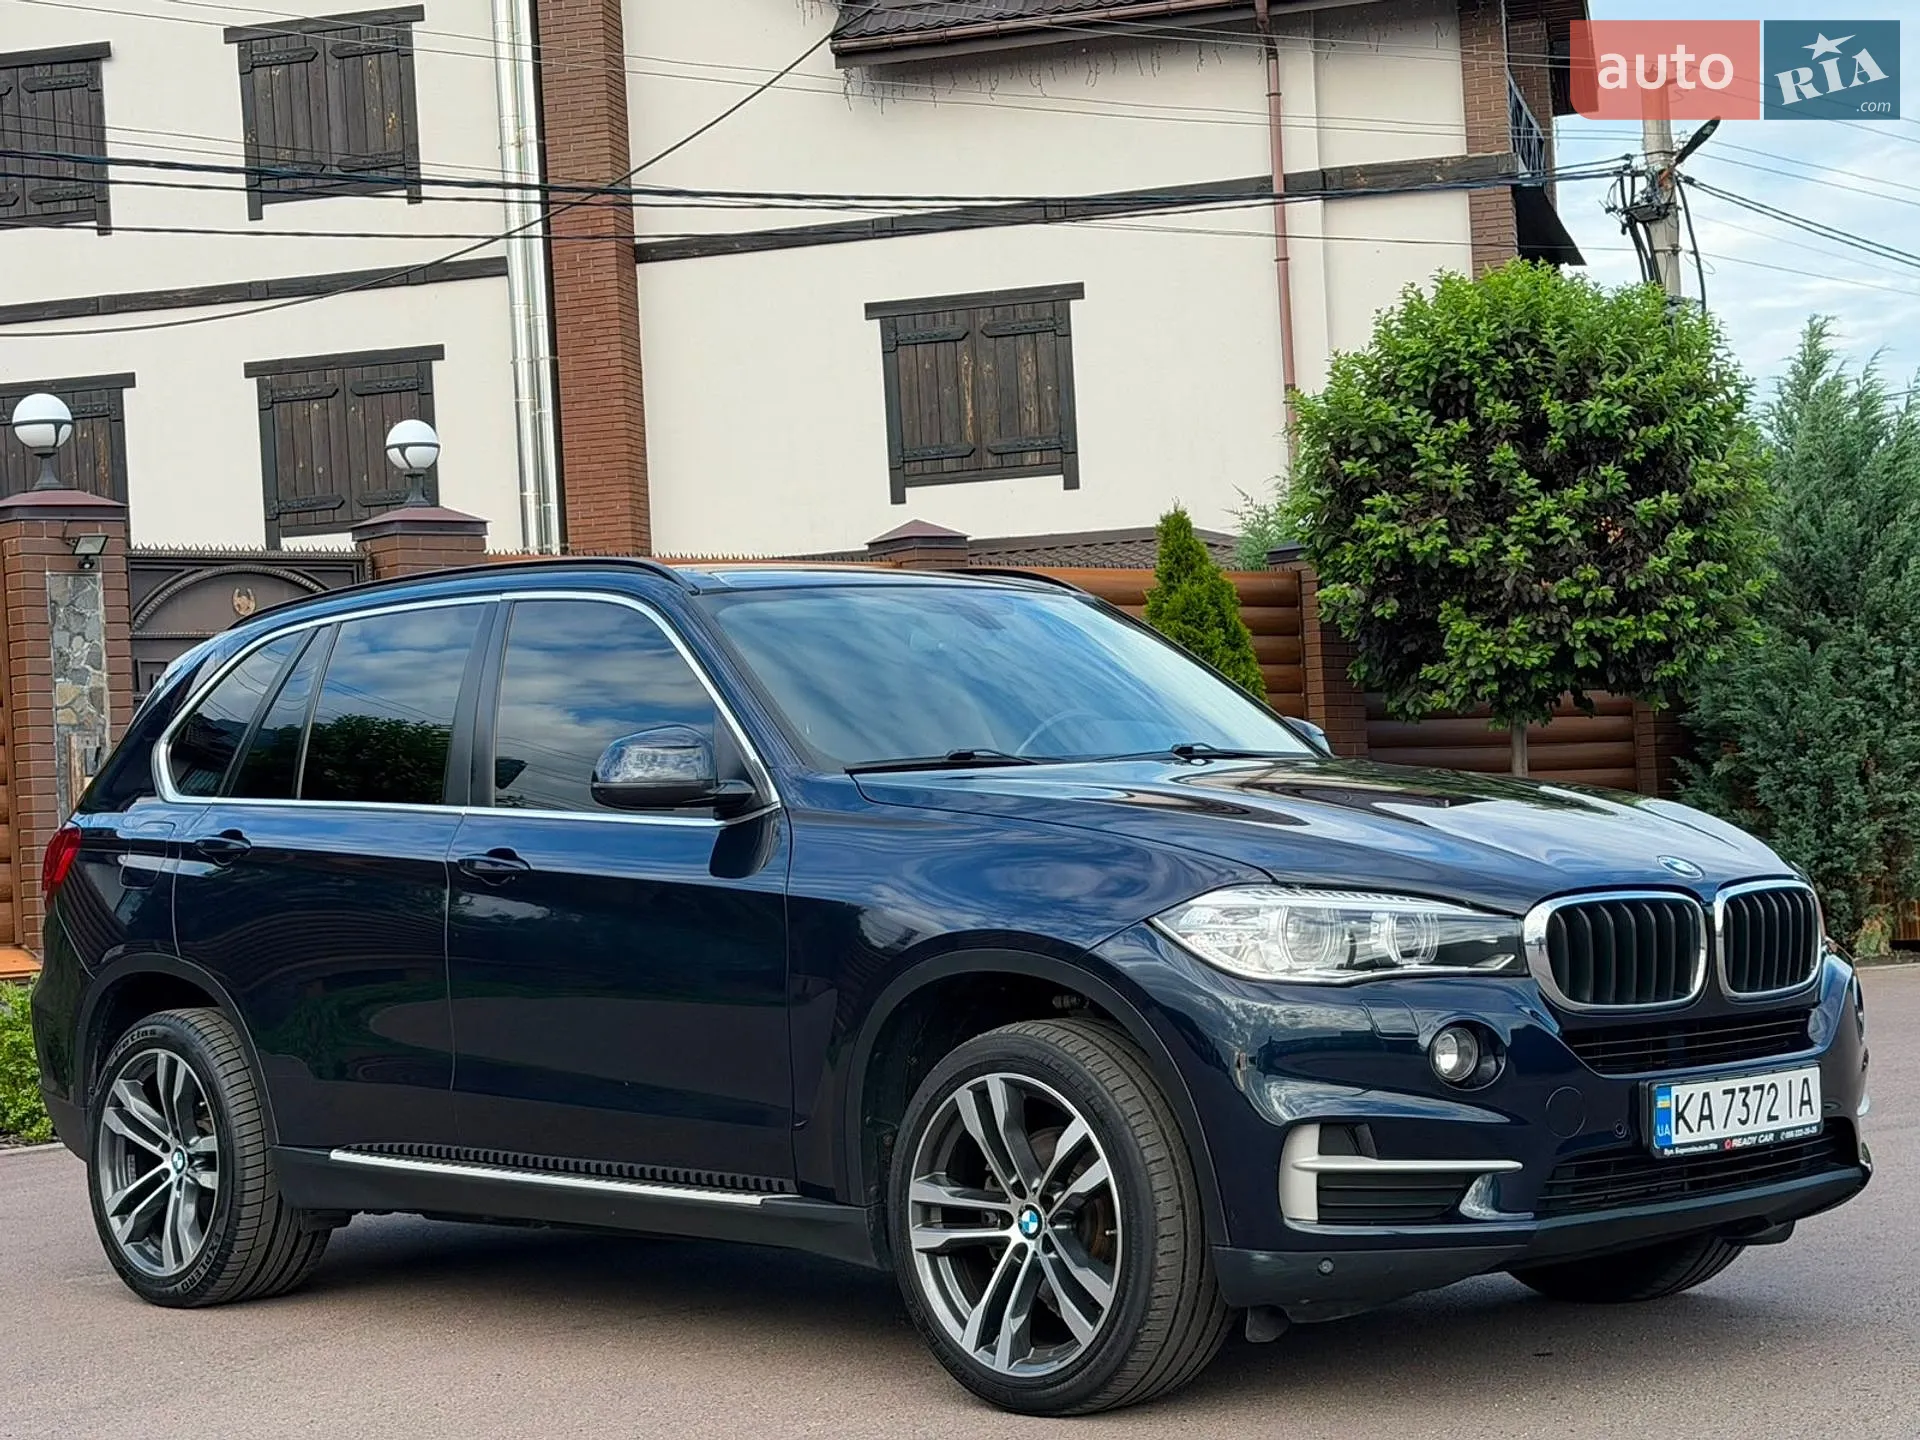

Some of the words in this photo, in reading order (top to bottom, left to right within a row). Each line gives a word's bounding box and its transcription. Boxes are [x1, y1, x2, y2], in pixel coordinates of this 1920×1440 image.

[1674, 1091, 1716, 1135] KA
[1721, 1082, 1780, 1129] 7372
[1788, 1076, 1814, 1119] IA
[1657, 1124, 1671, 1138] UA
[1732, 1136, 1756, 1148] READY
[1758, 1132, 1775, 1144] CAR
